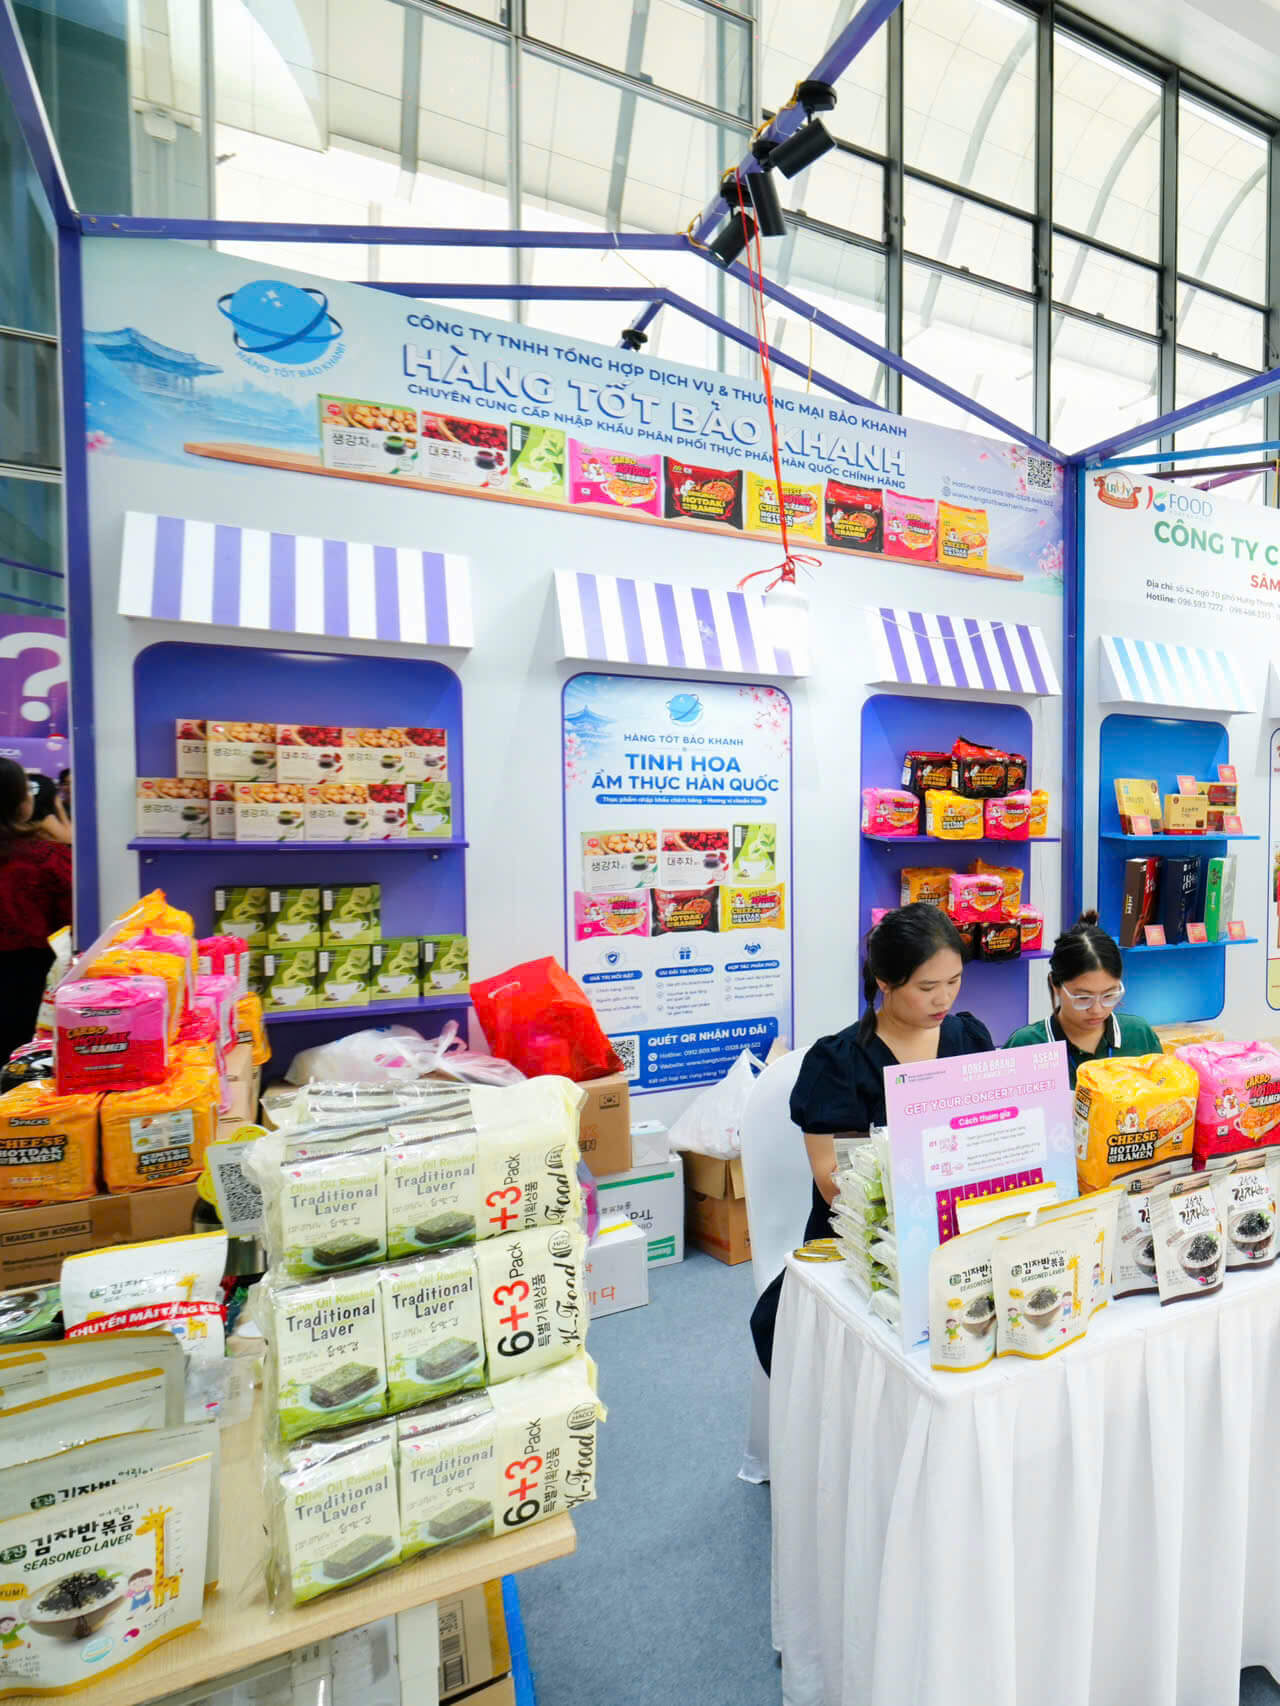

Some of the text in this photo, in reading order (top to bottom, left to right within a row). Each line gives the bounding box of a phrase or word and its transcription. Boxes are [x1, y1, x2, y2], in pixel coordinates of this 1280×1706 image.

[407, 314, 463, 336] CÔNG
[470, 328, 492, 343] TY
[497, 334, 548, 357] TNHH
[554, 347, 603, 368] TỔNG
[608, 360, 644, 377] HỢP
[649, 370, 688, 387] DỊCH
[693, 379, 714, 393] VỤ
[719, 386, 728, 396] &
[799, 404, 824, 419] MẠI
[829, 408, 858, 426] BẢO
[861, 419, 907, 437] KHANH
[403, 343, 906, 476] HÀNG TỐT BẢO KHANH
[408, 384, 471, 405] CHUYÊN
[476, 397, 517, 414] CUNG
[521, 405, 550, 419] CẤP
[554, 412, 592, 428] NHẬP
[637, 428, 673, 445] PHÂN
[710, 443, 743, 458] THỰC
[782, 457, 805, 469] HÀN
[809, 463, 839, 477] QUỐC
[842, 469, 875, 483] CHÍNH
[1169, 493, 1213, 518] FOOD
[1154, 519, 1224, 554] CÔNG
[1231, 537, 1259, 561] TY
[1251, 573, 1280, 592] SÂM
[1146, 592, 1176, 604] Hotline:
[708, 737, 744, 746] KHANH
[625, 753, 742, 772] TINH HOA
[628, 775, 681, 793] THỰC
[686, 774, 725, 791] HÀN
[729, 774, 779, 792] QUỐC
[648, 1024, 767, 1047] QUÉT QR NHẬN ƯU ĐÃI
[904, 1080, 1056, 1116] GET YOUR CONCERT TICKET!
[959, 1115, 981, 1126] Cách
[1107, 1129, 1158, 1146] CHEESE
[1108, 1142, 1155, 1155] HOTDAK
[1116, 1150, 1154, 1163] RAMEN
[395, 1164, 475, 1189] Traditional
[417, 1180, 456, 1196] Laver
[290, 1184, 379, 1209] Traditional
[486, 1154, 522, 1230] +3 Pack
[315, 1200, 358, 1216] Laver
[524, 1182, 538, 1229] 기획상품
[4, 1223, 87, 1243] MADE IN KOREA
[392, 1277, 473, 1310] Traditional
[493, 1242, 534, 1357] 6+3 Pack
[286, 1299, 376, 1333] Traditional
[416, 1299, 455, 1319] Laver
[312, 1322, 355, 1343] Laver
[410, 1446, 494, 1483] Traditional
[432, 1466, 473, 1486] Laver
[503, 1417, 543, 1526] 6+3 Pack
[295, 1476, 389, 1520] Traditional
[322, 1500, 367, 1524] Laver
[30, 1514, 134, 1557] 김자반볶음
[24, 1533, 134, 1572] SEASONED LAVER
